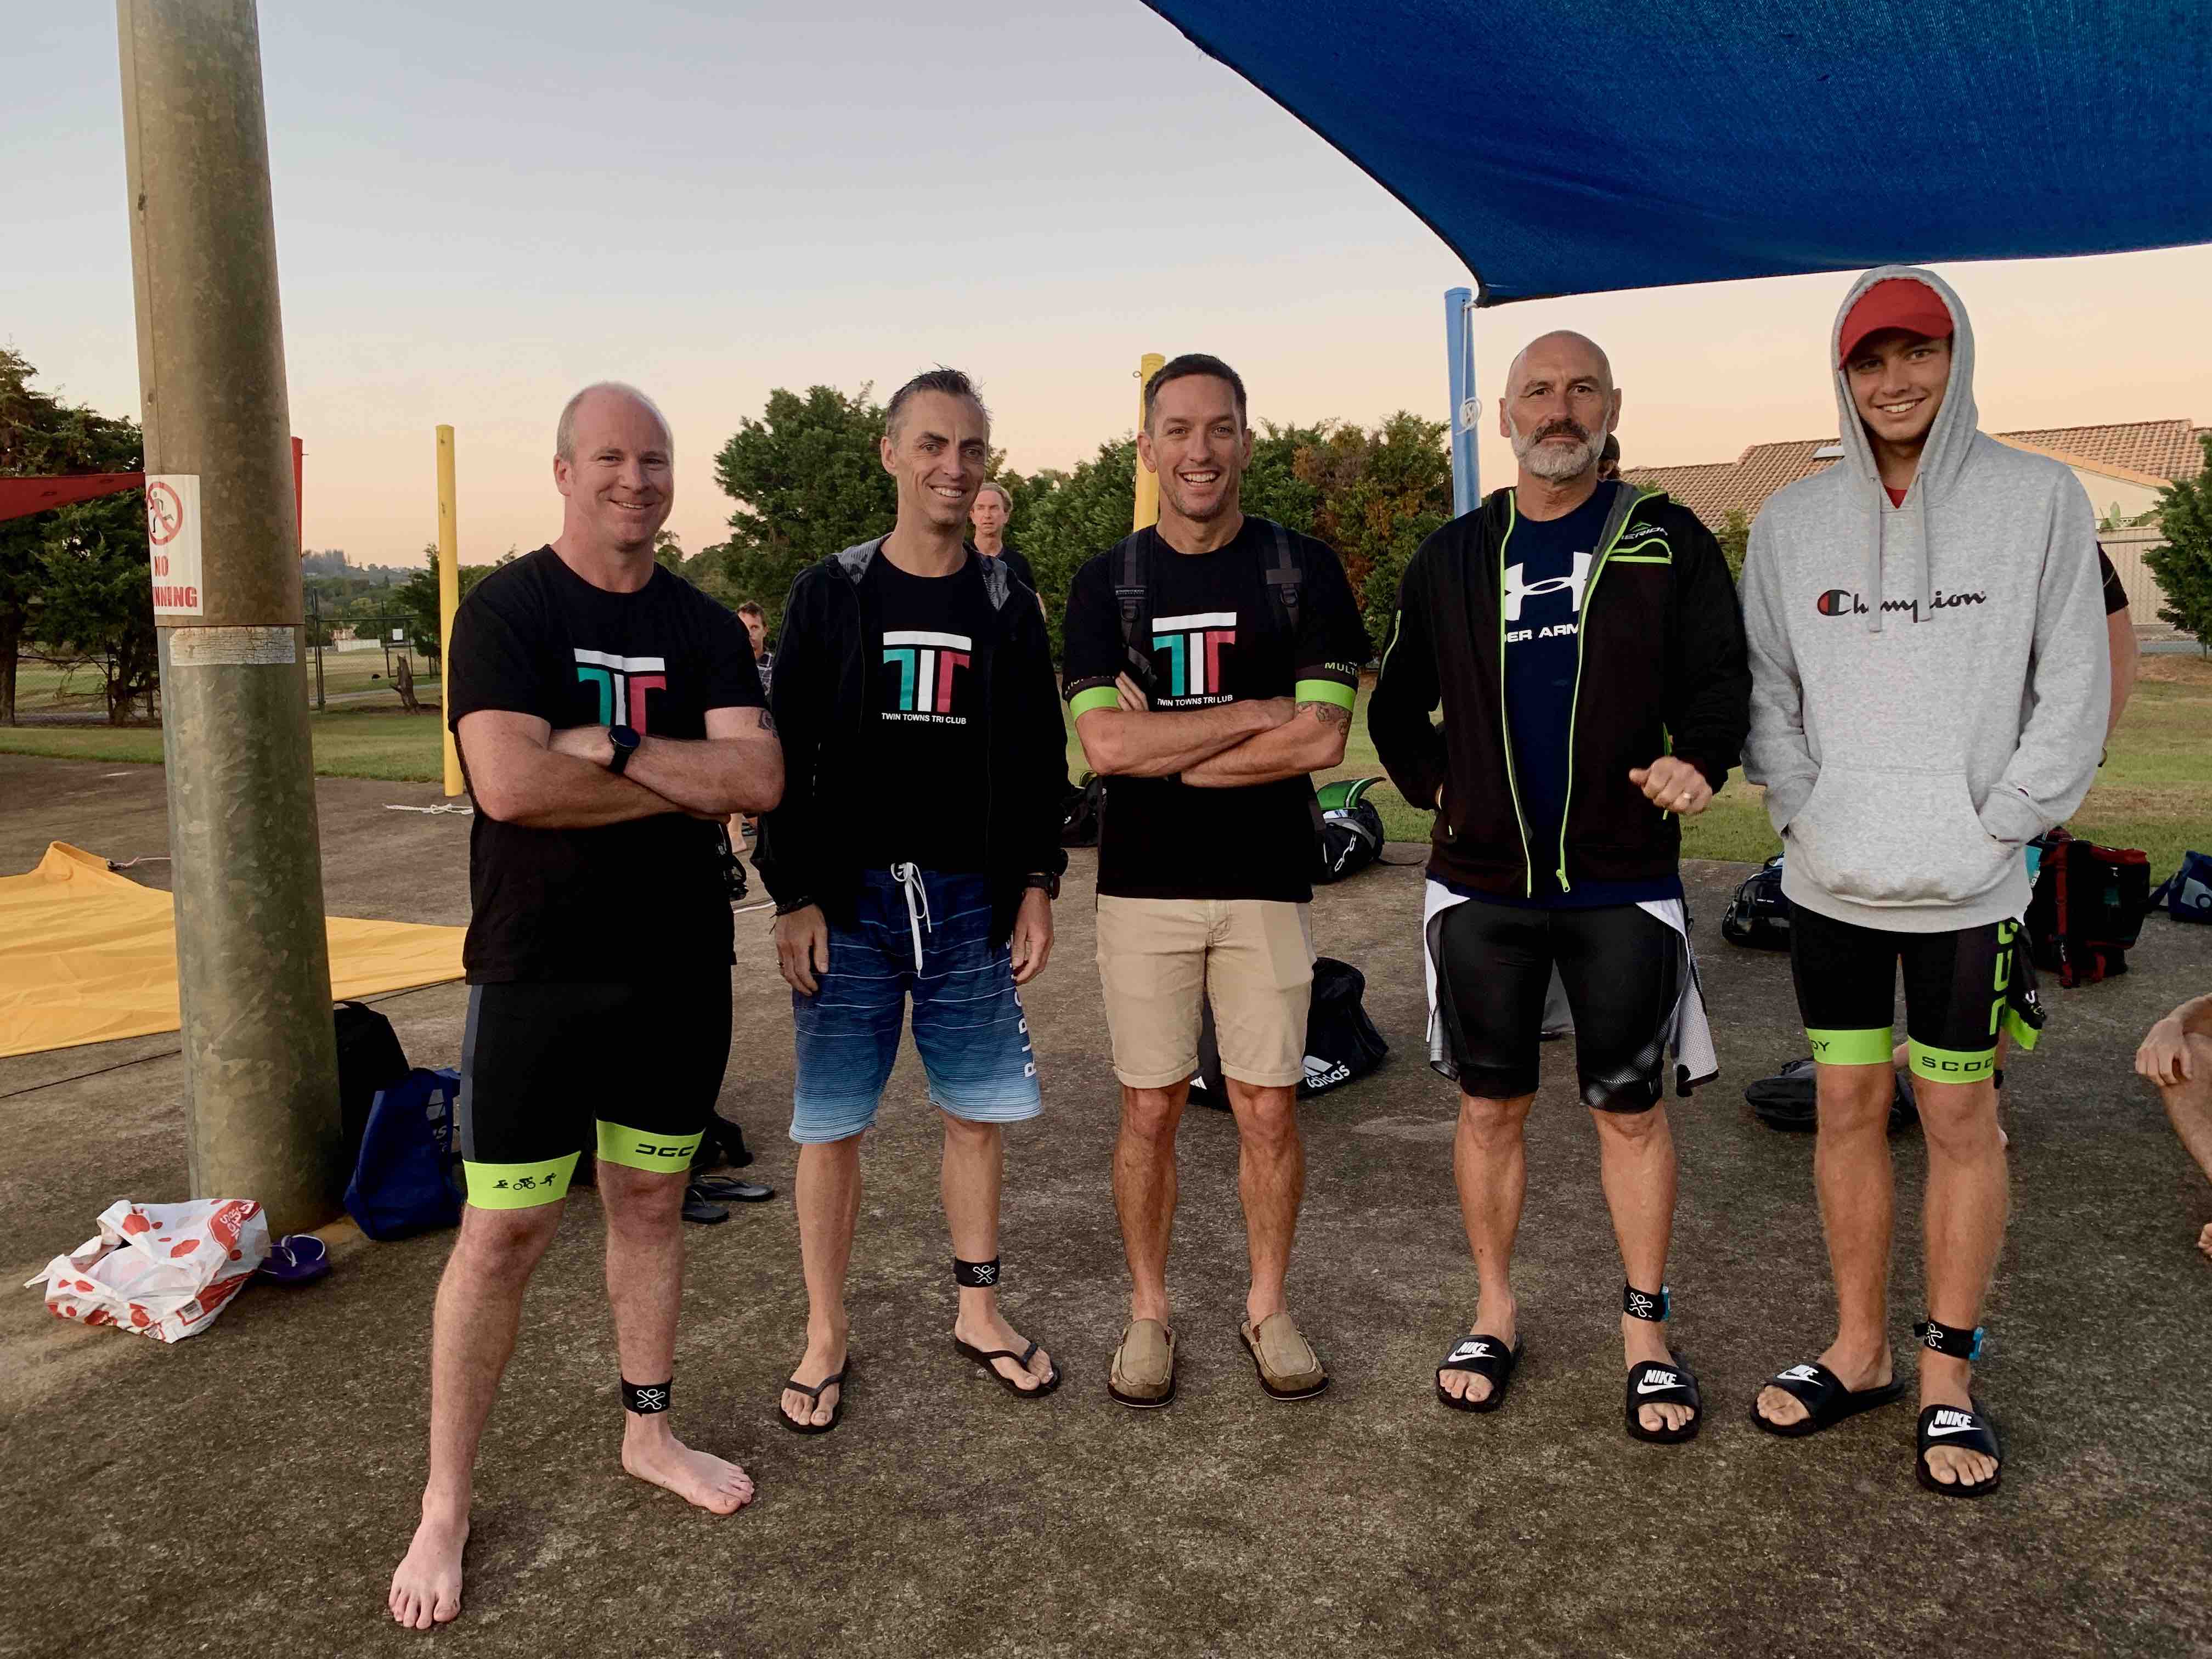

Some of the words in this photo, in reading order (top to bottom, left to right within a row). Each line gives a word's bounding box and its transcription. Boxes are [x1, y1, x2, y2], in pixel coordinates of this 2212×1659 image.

[1621, 527, 1668, 540] ERIDA
[155, 556, 168, 576] NO
[153, 586, 198, 607] NNING
[1817, 590, 1987, 623] Chmion
[1504, 629, 1532, 643] ER
[1175, 698, 1202, 706] TOWNS
[1217, 695, 1233, 703] LUB
[902, 714, 930, 722] TOWNS
[1457, 1342, 1489, 1354] NIKE
[1644, 1369, 1677, 1385] NIKE
[1934, 1410, 1972, 1427] NIKE
